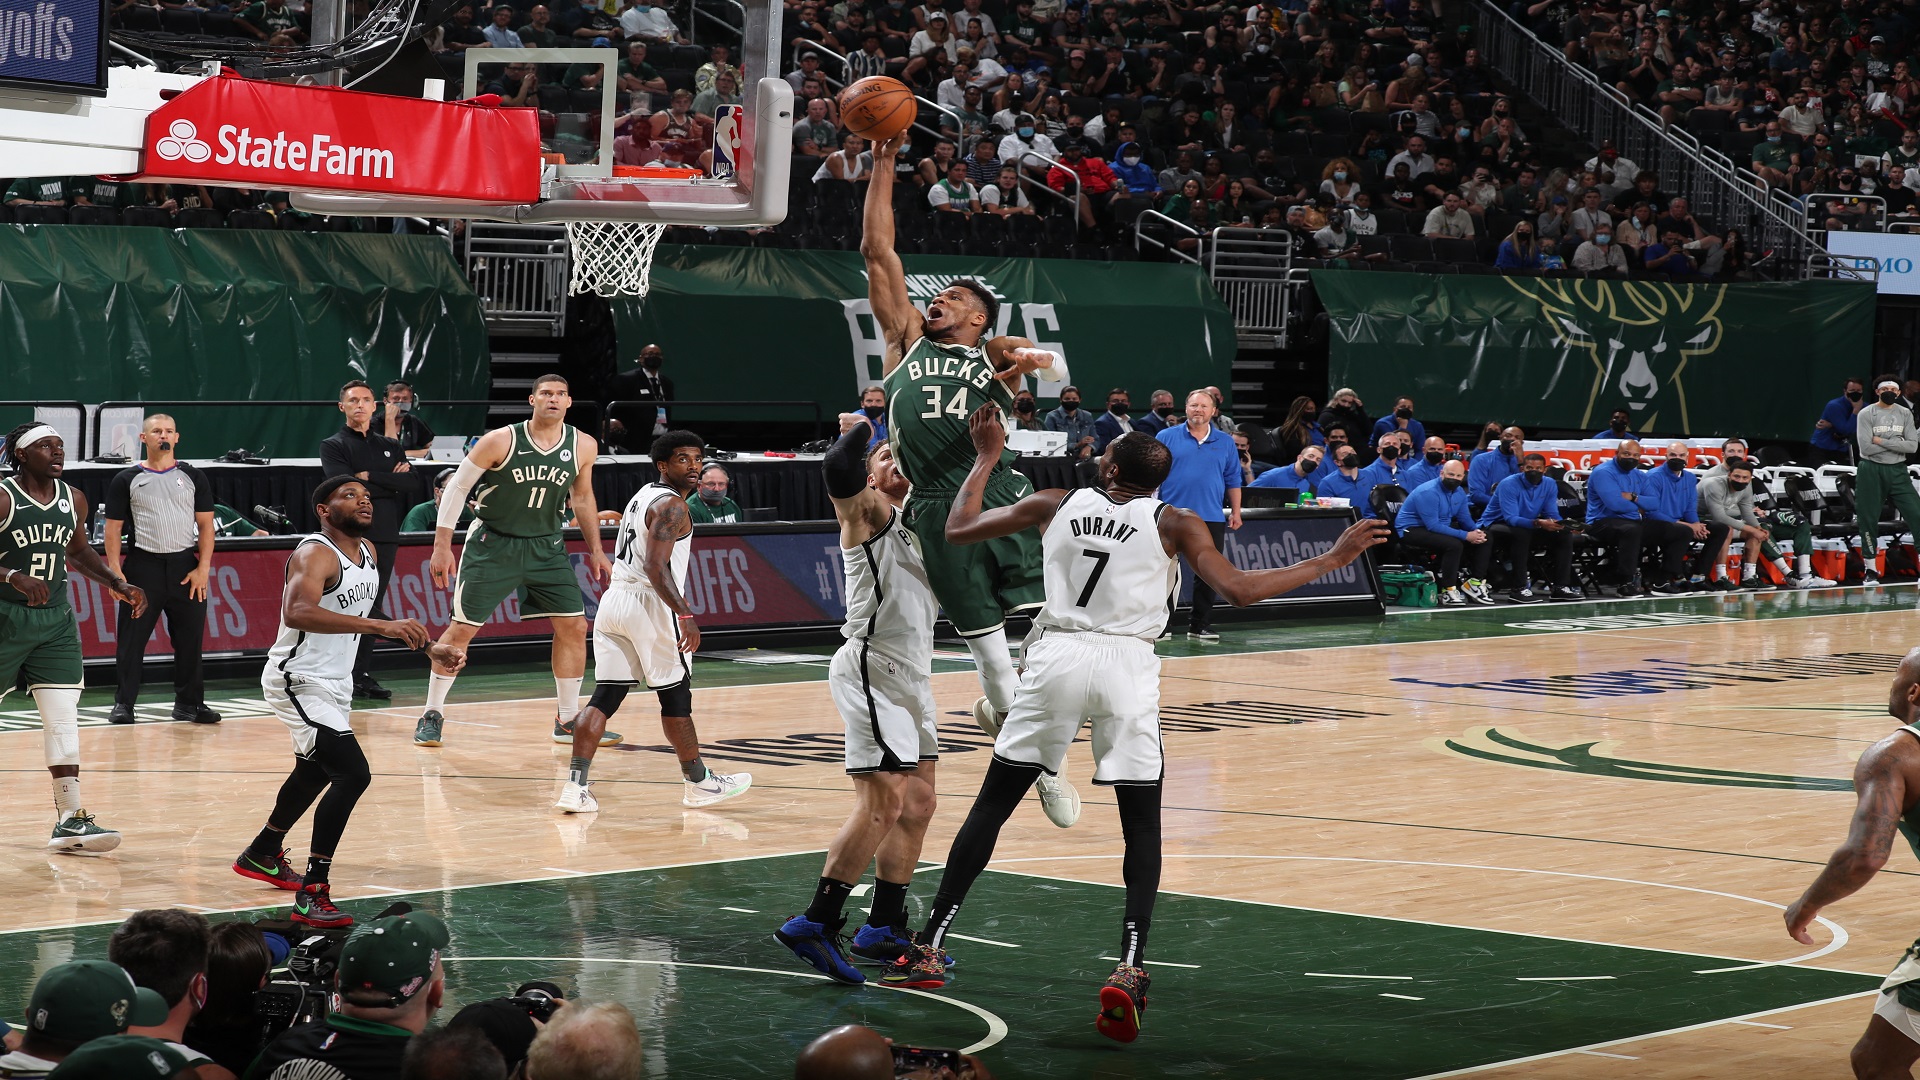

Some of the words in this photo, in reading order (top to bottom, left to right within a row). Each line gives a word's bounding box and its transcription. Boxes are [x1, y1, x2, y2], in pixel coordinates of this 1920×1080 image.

[907, 357, 993, 389] BUCKS
[921, 385, 968, 420] 34
[511, 464, 570, 487] BUCKS
[527, 486, 547, 509] 11
[11, 523, 74, 549] BUCKS
[1070, 516, 1138, 543] DURANT
[29, 552, 57, 580] 21
[1075, 548, 1110, 608] 7
[336, 582, 379, 609] BROOKL
